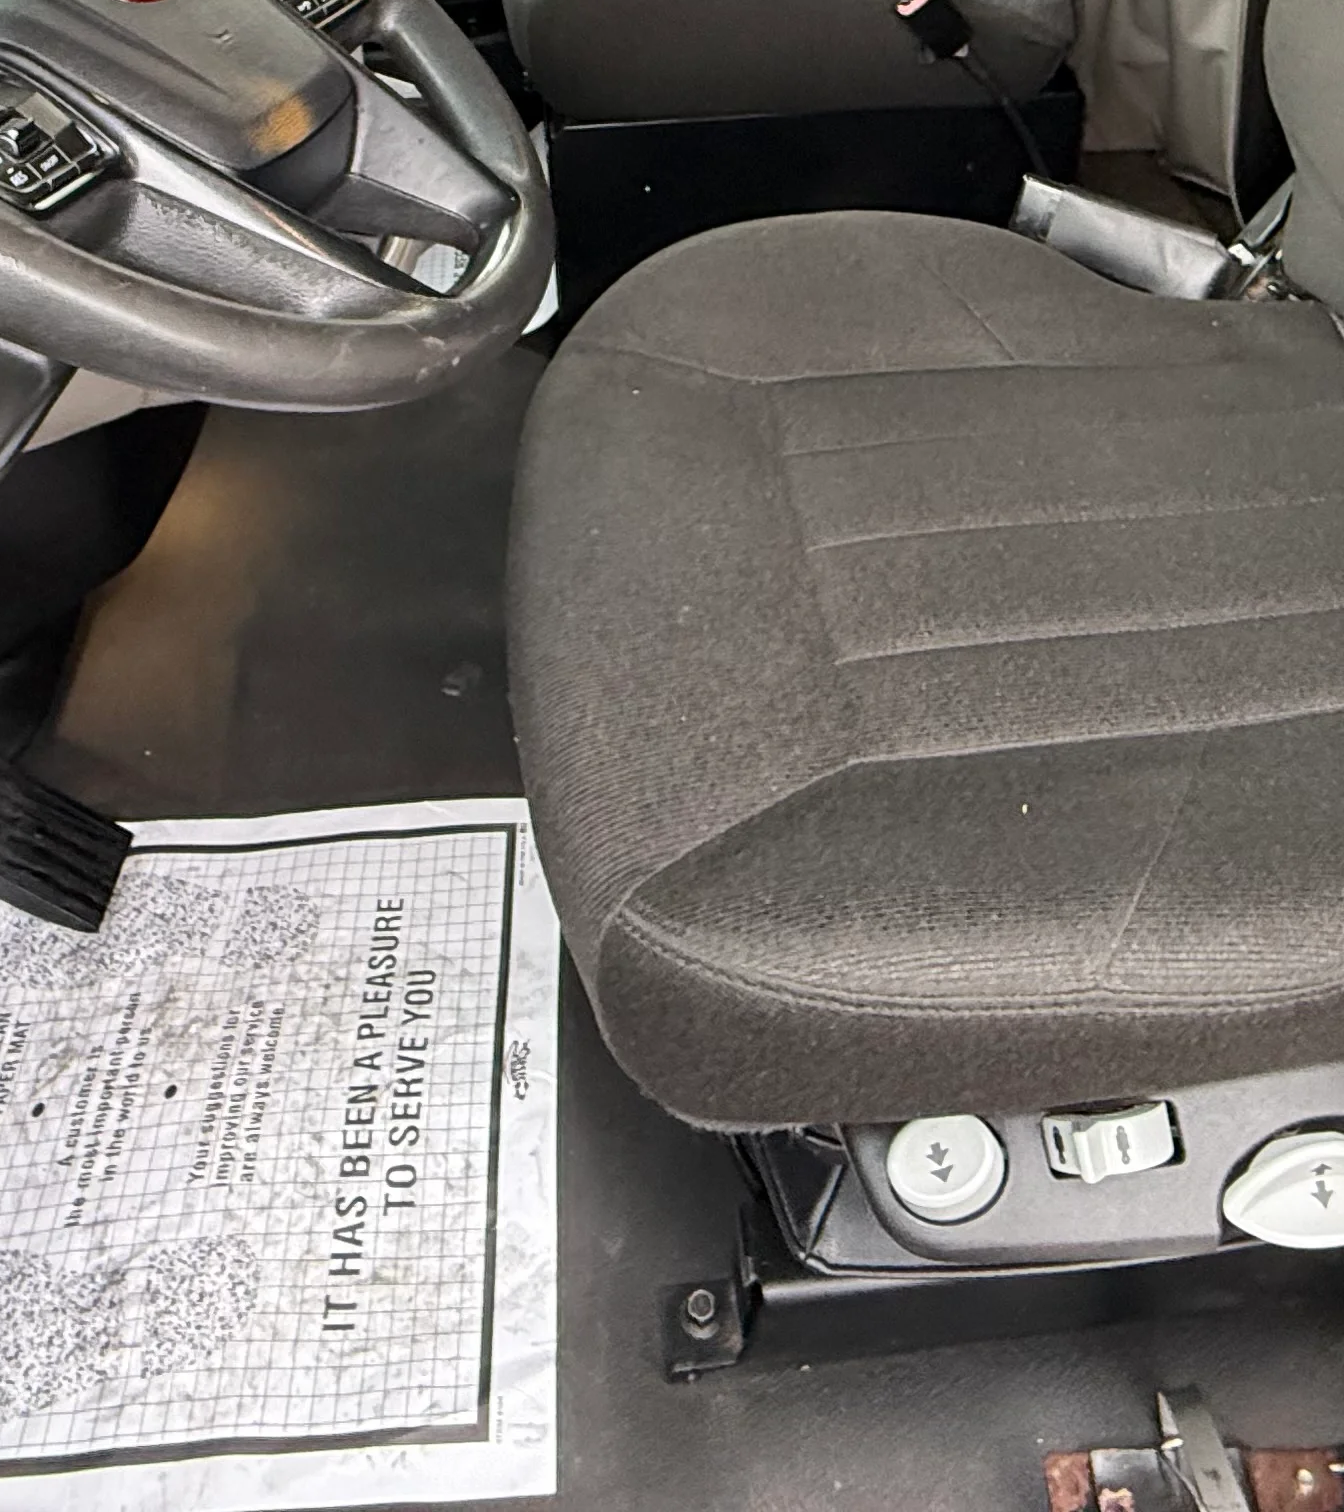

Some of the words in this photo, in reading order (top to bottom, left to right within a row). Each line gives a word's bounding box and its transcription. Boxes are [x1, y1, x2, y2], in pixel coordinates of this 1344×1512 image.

[357, 898, 405, 1040] PLEASURE
[116, 992, 141, 1045] person
[402, 969, 437, 1025] YOU
[8, 1020, 32, 1055] MAT
[240, 1000, 264, 1055] service
[128, 1051, 146, 1068] to
[233, 1060, 251, 1086] our
[354, 1051, 383, 1071] A
[57, 1155, 75, 1166] A
[66, 1068, 97, 1148] customer
[87, 1045, 104, 1059] is
[85, 1051, 124, 1136] important
[117, 1073, 140, 1123] world
[186, 1140, 210, 1183] Your
[200, 1034, 235, 1134] suggestions
[222, 1010, 240, 1029] for
[244, 1081, 270, 1143] always
[389, 1036, 429, 1146] SERVE
[106, 1128, 125, 1157] the
[209, 1093, 246, 1188] improving
[340, 1085, 379, 1178] BEEN
[77, 1141, 100, 1188] most
[98, 1164, 117, 1182] in
[240, 1151, 257, 1182] are
[383, 1164, 418, 1216] TO
[64, 1197, 86, 1228] the
[328, 1195, 367, 1276] HAS
[321, 1295, 357, 1331] IT
